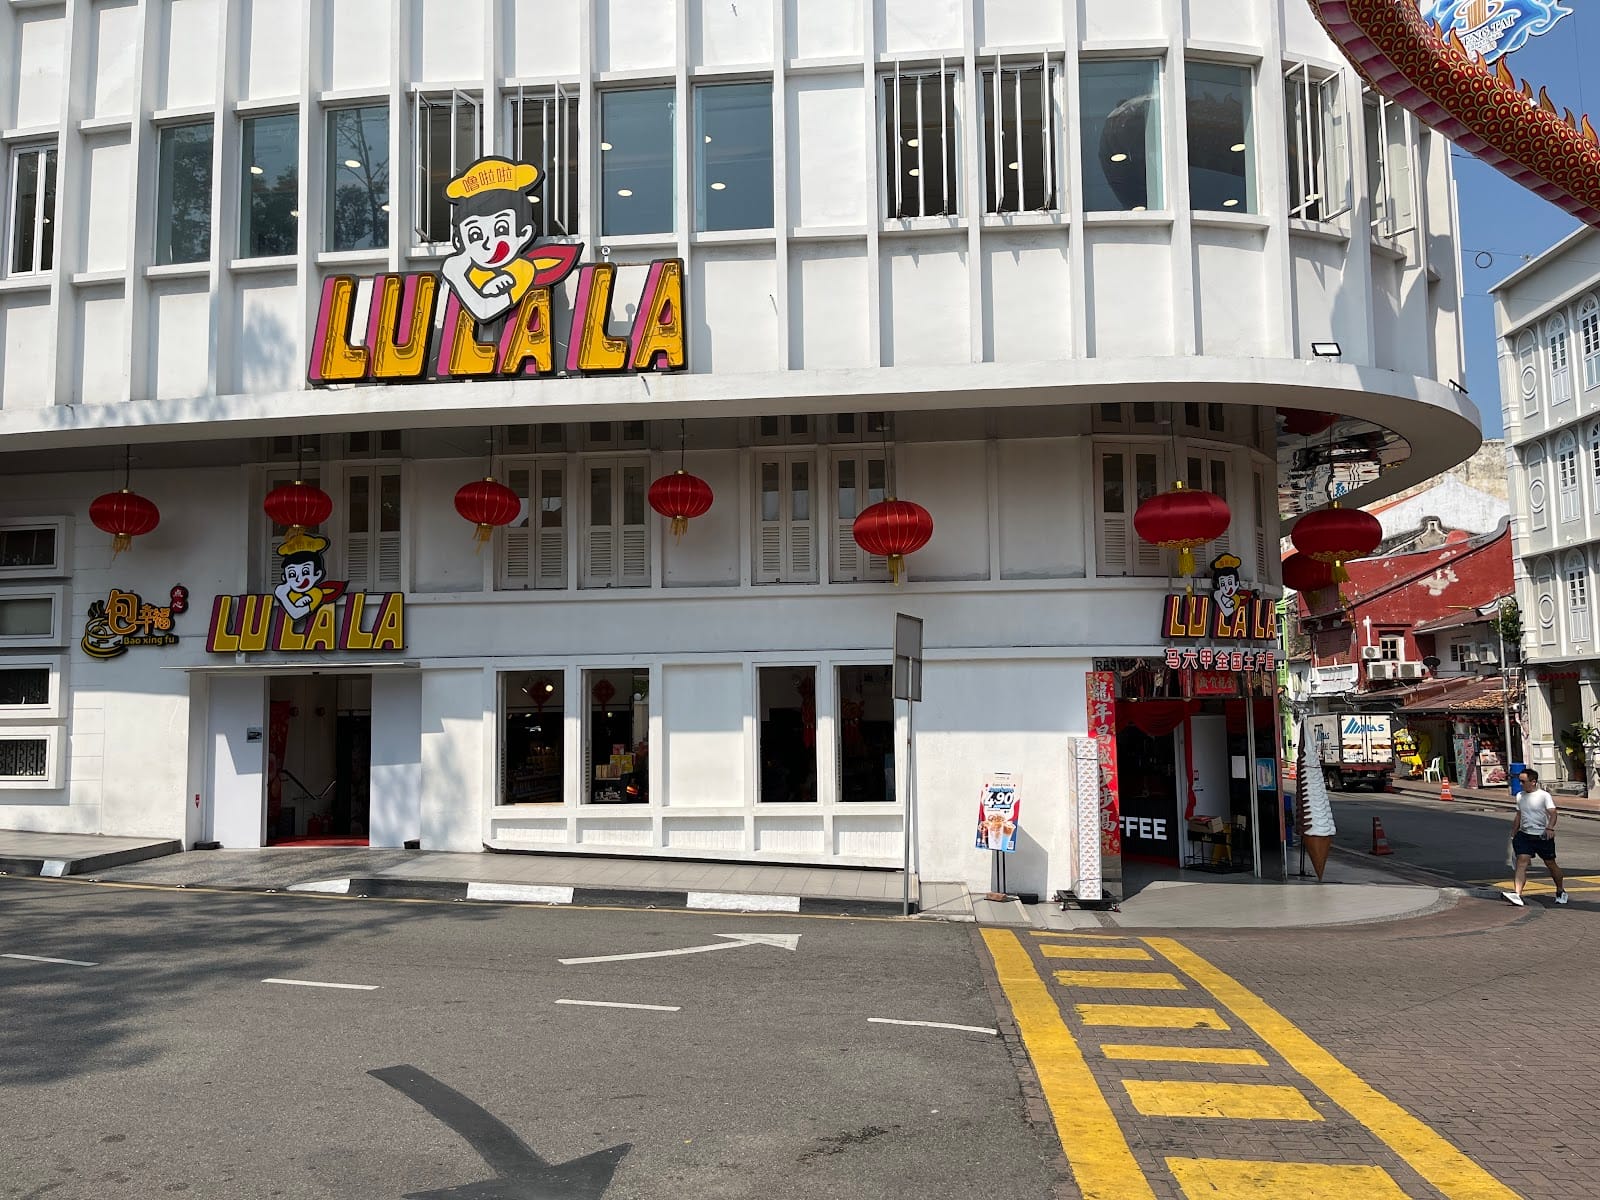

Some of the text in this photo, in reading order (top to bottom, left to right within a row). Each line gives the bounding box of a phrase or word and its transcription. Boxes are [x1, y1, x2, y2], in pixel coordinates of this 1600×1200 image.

[309, 260, 687, 382] LULALA
[123, 634, 175, 646] Bao xing fu
[206, 592, 404, 652] LULALA
